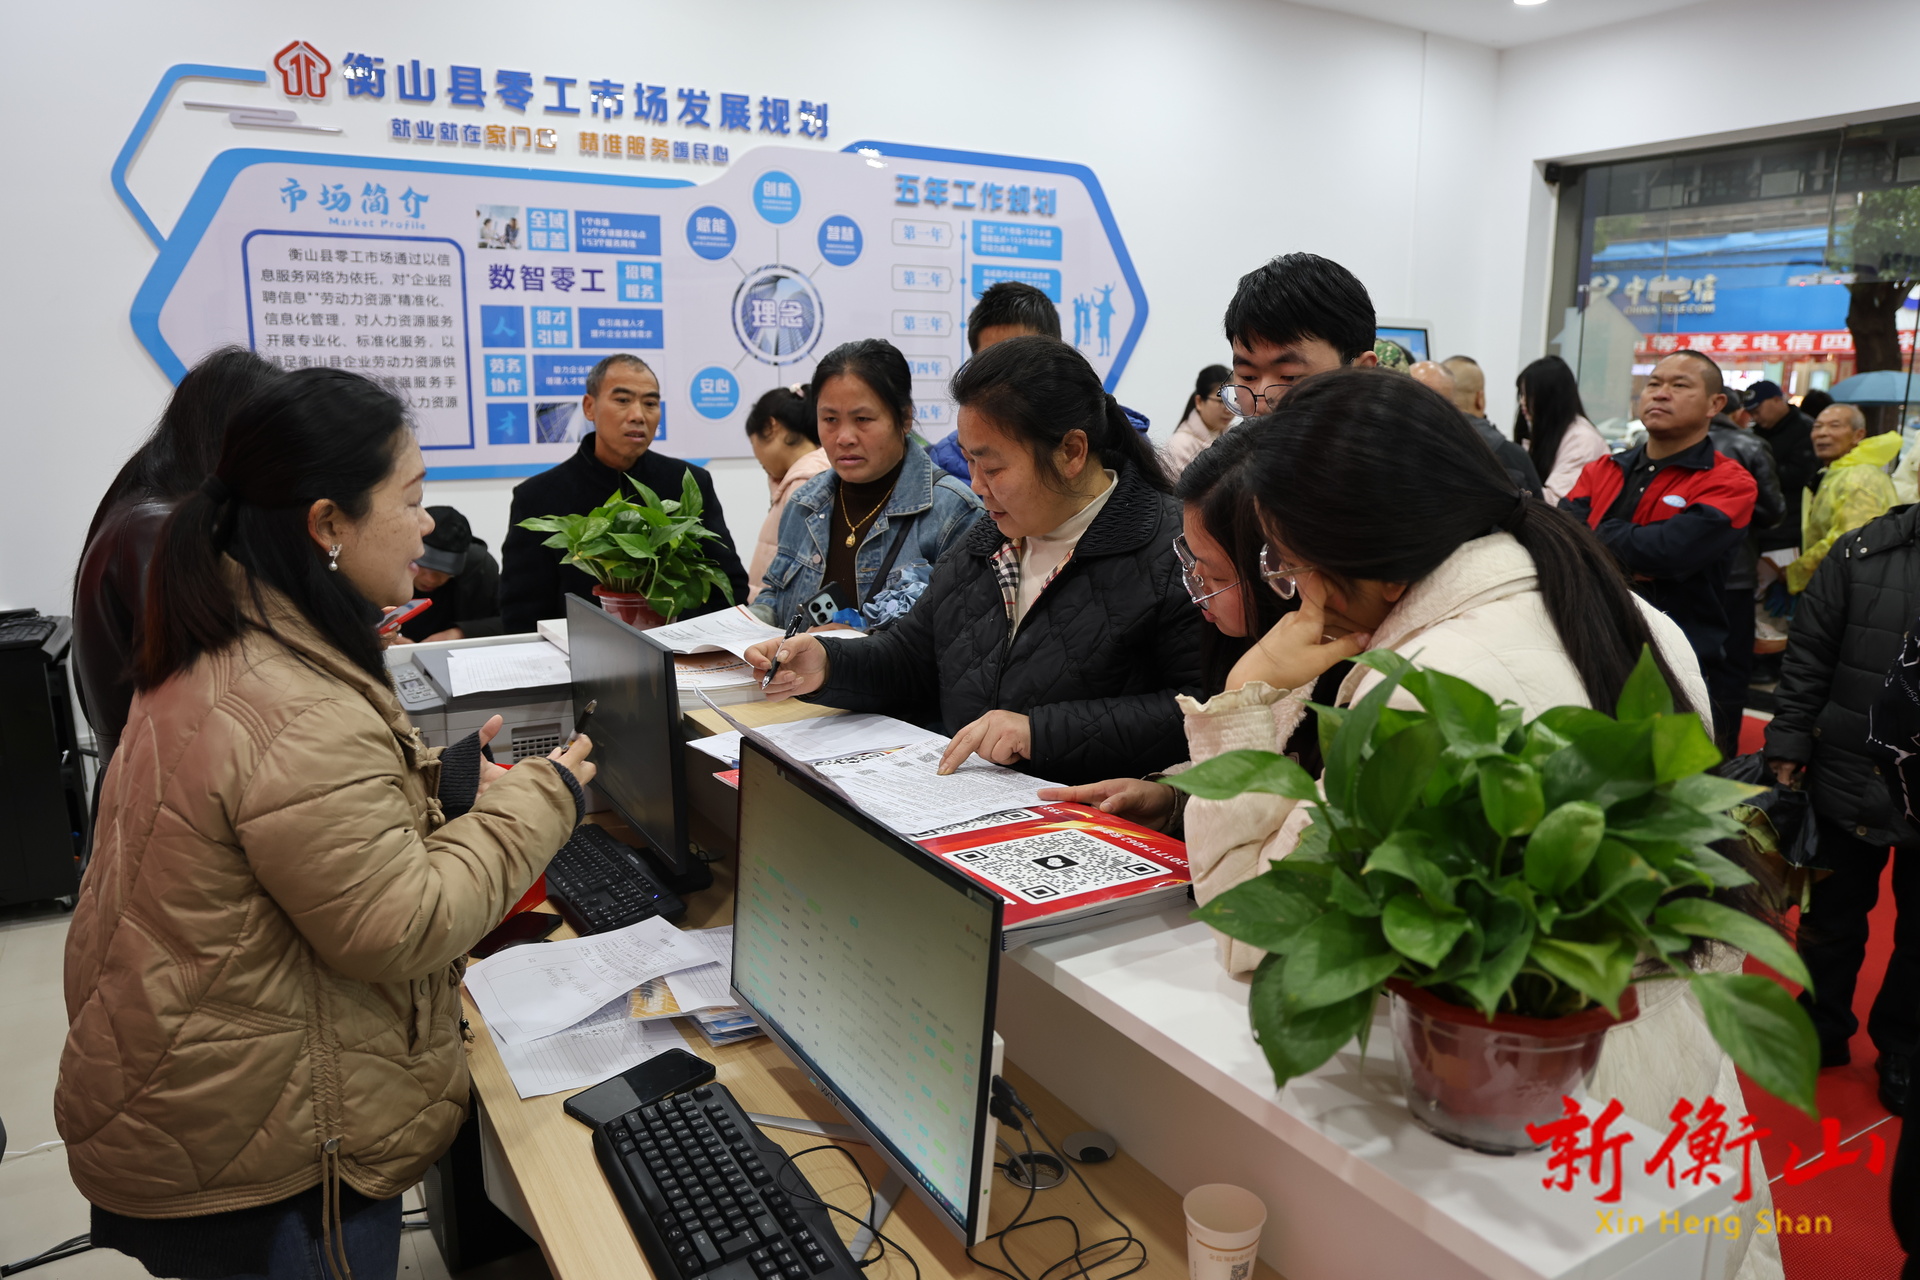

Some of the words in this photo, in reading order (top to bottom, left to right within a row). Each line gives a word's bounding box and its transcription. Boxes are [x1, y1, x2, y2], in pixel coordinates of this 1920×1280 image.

[343, 52, 829, 138] 衡山县零工市场发展规划
[391, 118, 557, 149] 就业就在家门口
[579, 131, 729, 162] 精准服务暖民心
[279, 177, 430, 219] 市场简介
[894, 174, 1057, 216] 五年工作规划
[328, 216, 374, 228] Market
[380, 218, 426, 231] Profile
[530, 211, 566, 229] 全域
[695, 216, 727, 234] 赋能
[531, 230, 566, 249] 覆盖
[903, 224, 943, 242] 第一年
[288, 248, 450, 267] 衡山县零工市场通过以信
[488, 263, 606, 293] 数智零工
[625, 264, 654, 280] 招聘
[903, 270, 943, 288] 第二年
[625, 284, 654, 299] 服务
[536, 310, 566, 325] 招才
[751, 299, 803, 328] 理念
[492, 316, 517, 337] 人
[903, 315, 943, 331] 第三年
[537, 329, 567, 345] 引智
[489, 357, 521, 374] 劳务
[490, 377, 522, 394] 协作
[700, 378, 730, 394] 安心
